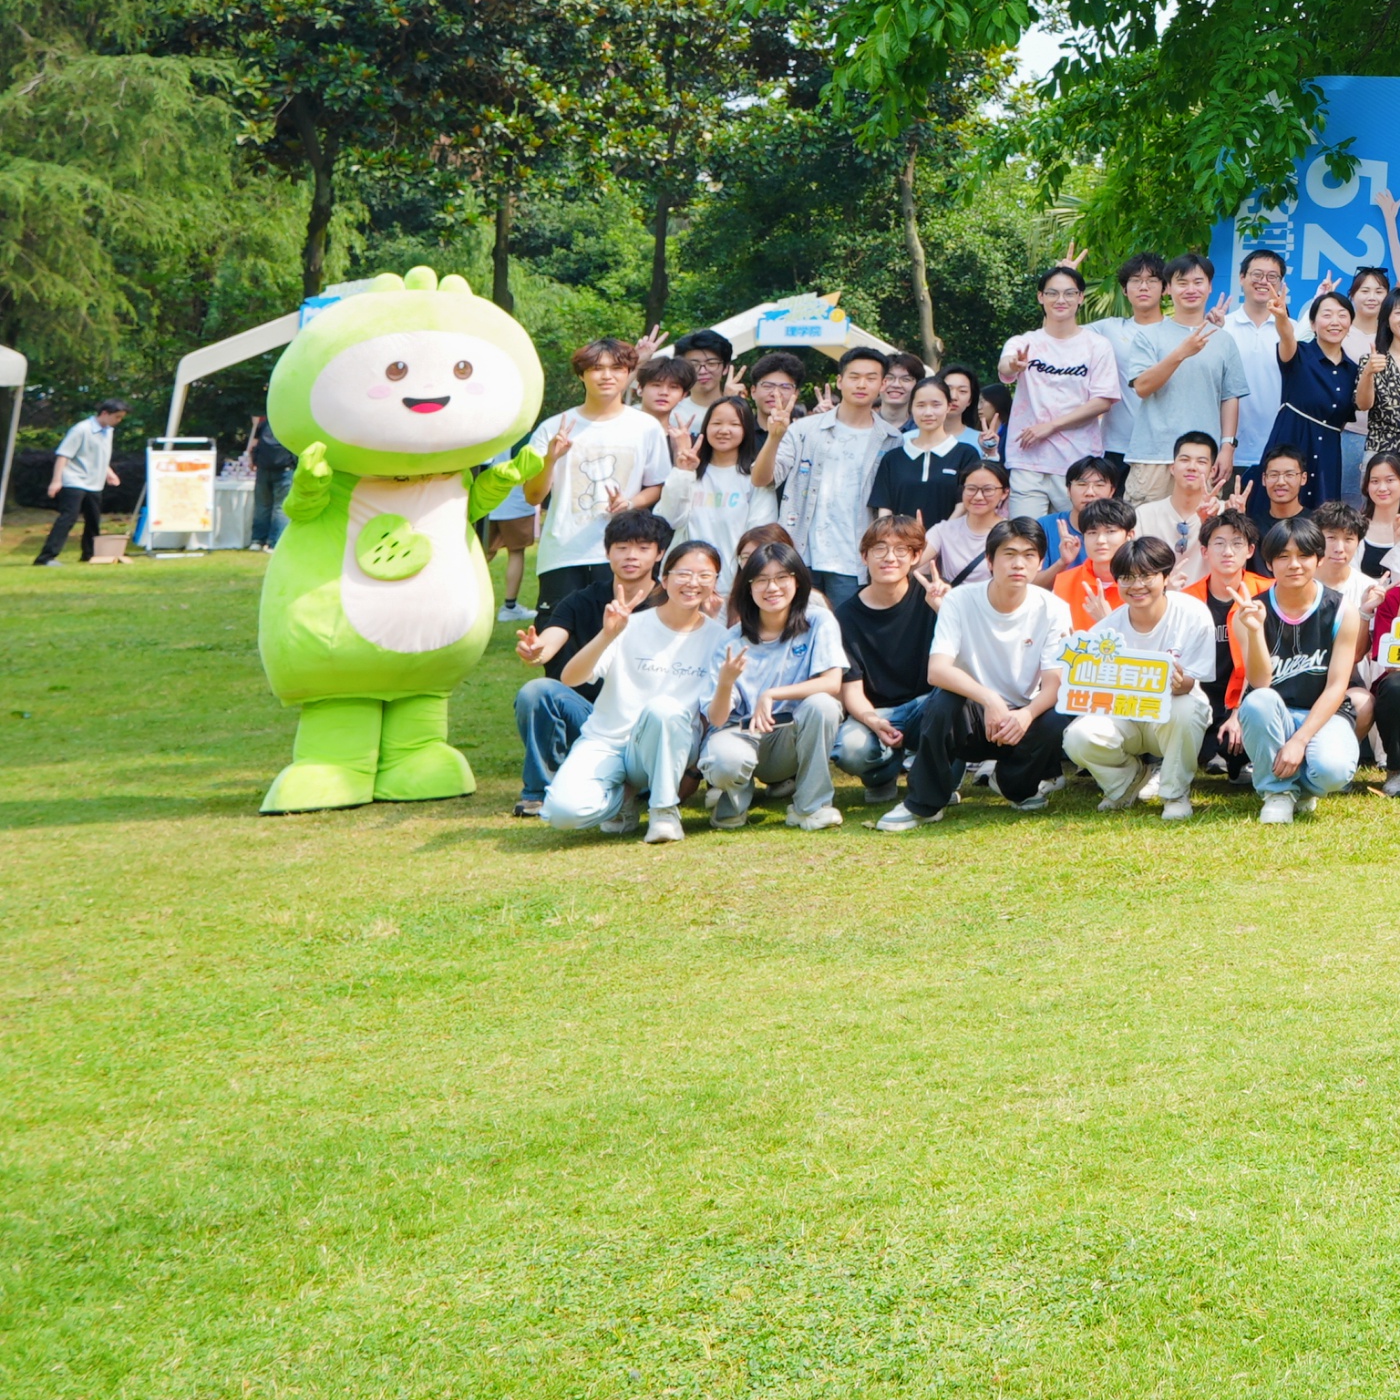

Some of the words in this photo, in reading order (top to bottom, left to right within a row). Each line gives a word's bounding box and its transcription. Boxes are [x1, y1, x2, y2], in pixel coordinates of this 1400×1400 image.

[1028, 359, 1089, 377] Peanuts
[634, 657, 669, 674] Team
[671, 662, 708, 681] Spirit
[1074, 660, 1162, 689] 心里有光
[1066, 689, 1162, 719] 世界就亮
